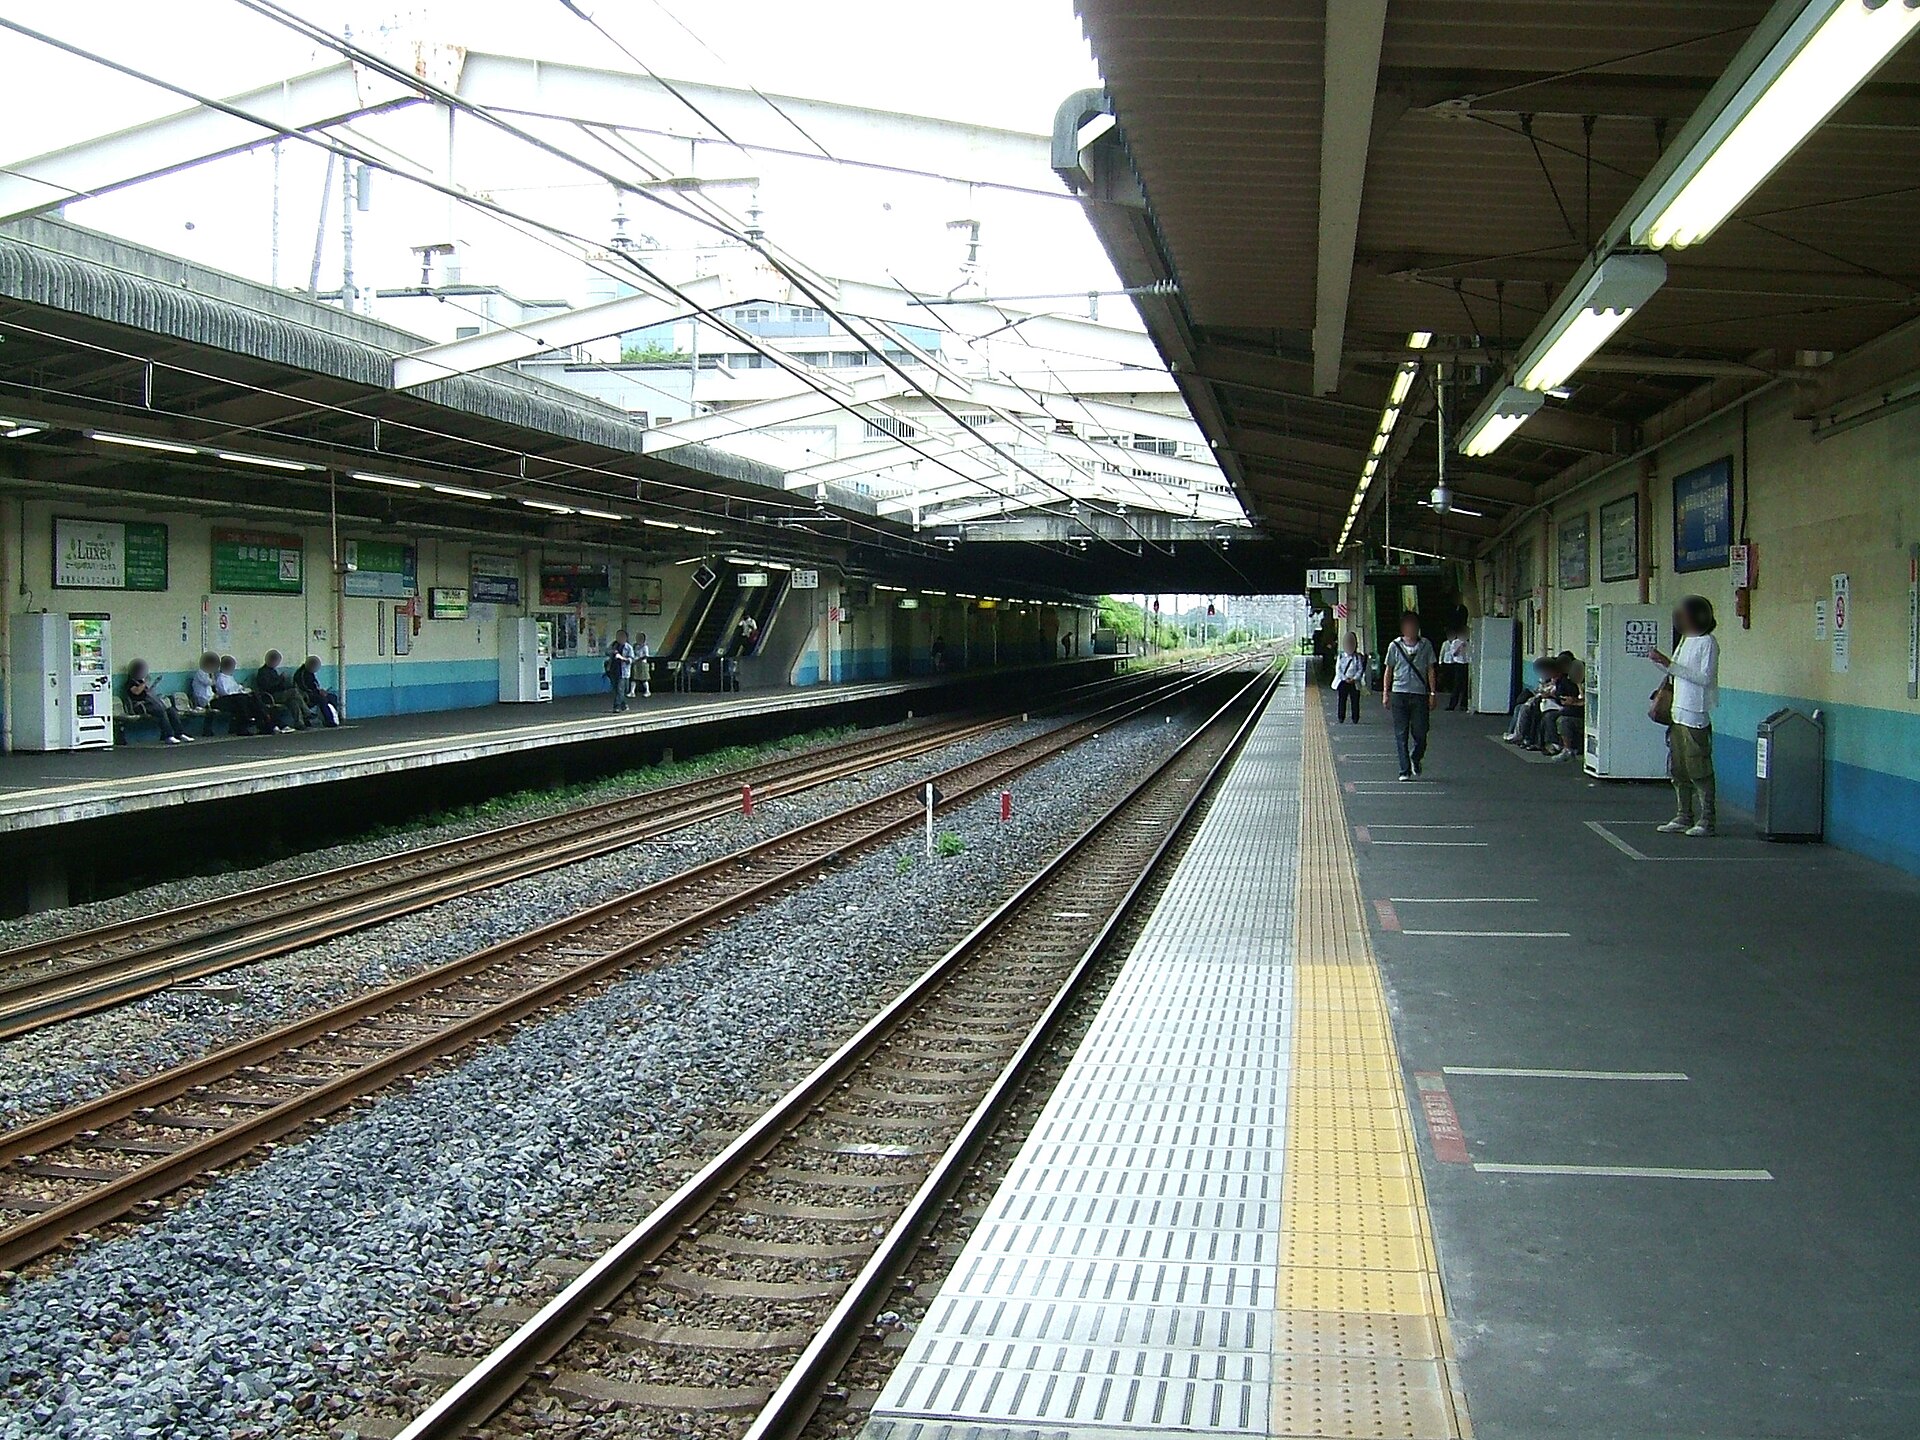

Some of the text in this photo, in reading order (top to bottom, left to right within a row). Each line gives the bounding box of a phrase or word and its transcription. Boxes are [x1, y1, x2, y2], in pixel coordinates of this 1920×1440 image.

[77, 539, 107, 560] Luxe
[601, 565, 607, 573] 2
[1627, 622, 1656, 633] OH
[1627, 634, 1656, 644] SHI
